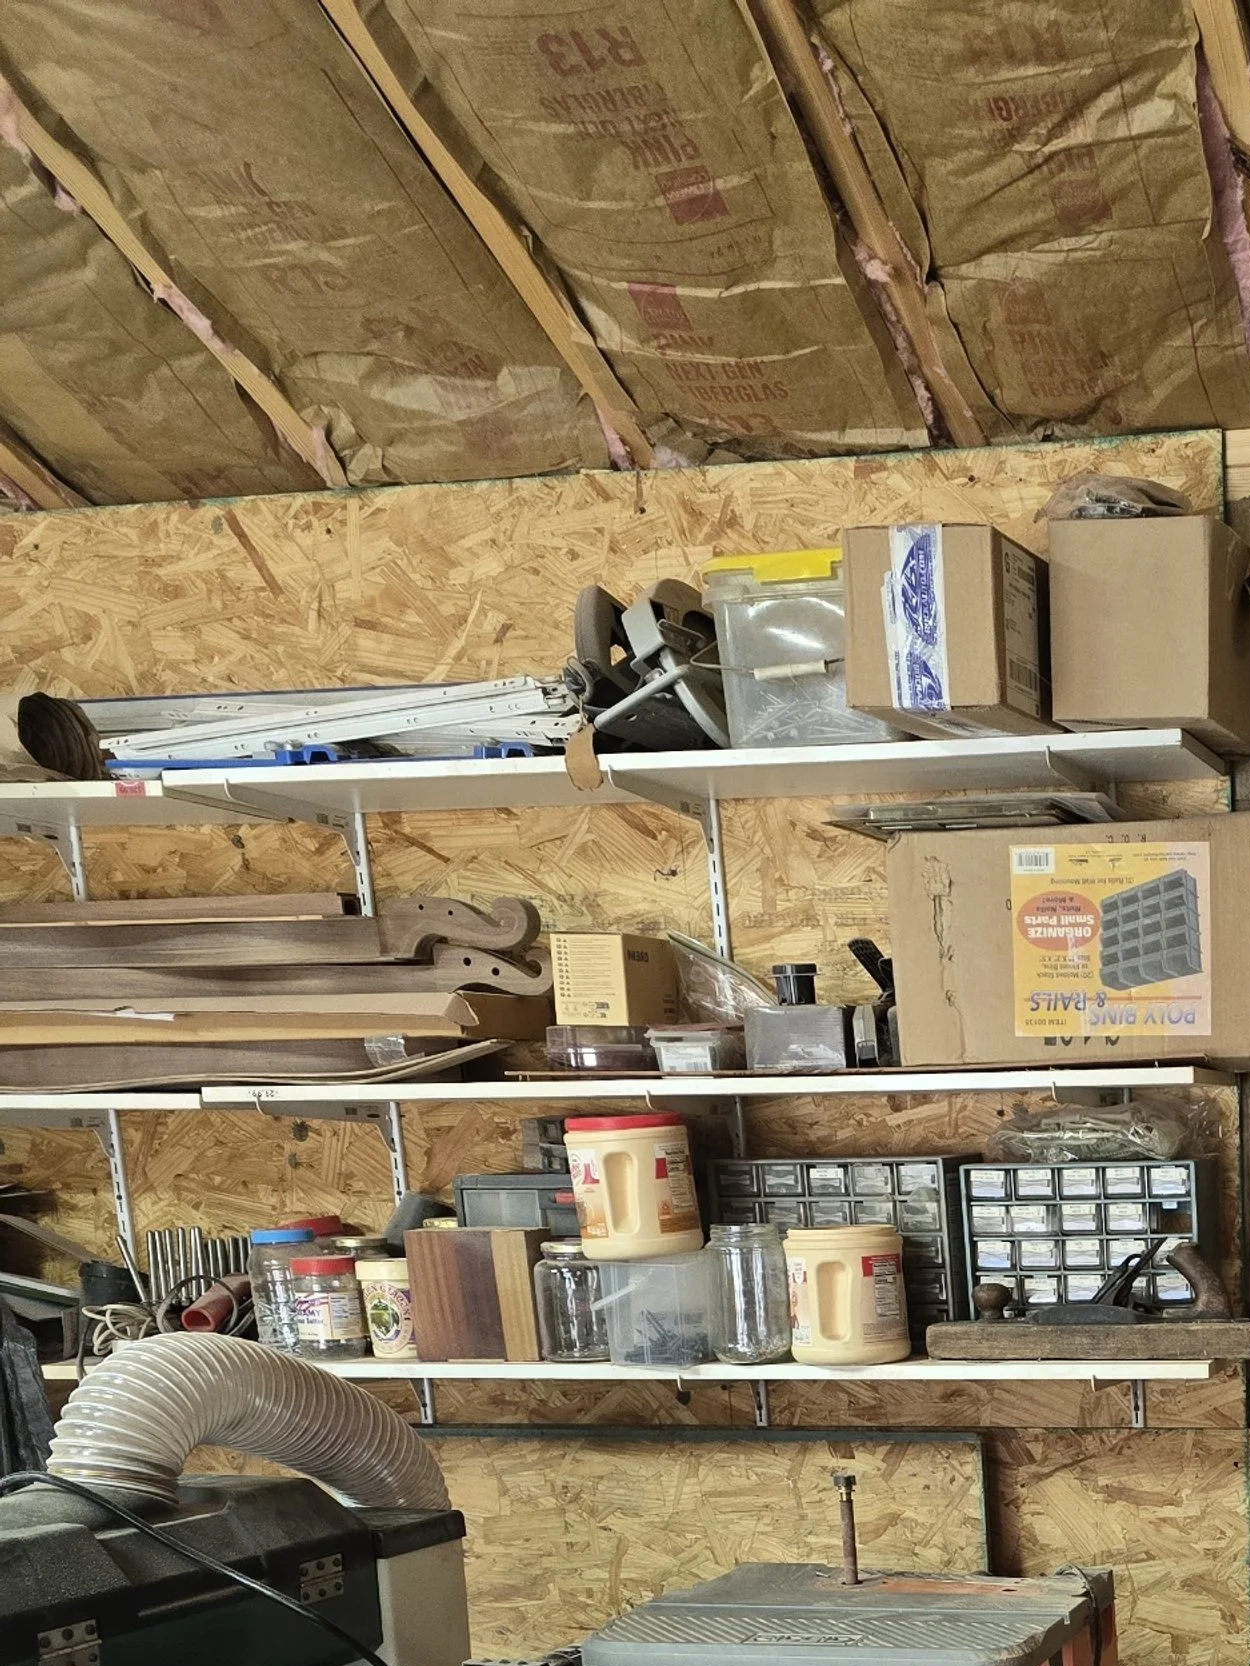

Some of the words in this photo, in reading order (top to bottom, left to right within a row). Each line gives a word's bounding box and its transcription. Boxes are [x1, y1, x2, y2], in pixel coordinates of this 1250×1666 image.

[537, 25, 648, 77] R13
[664, 361, 715, 381] NEXT
[1024, 914, 1058, 925] Parts
[1061, 914, 1095, 925] Small
[1028, 926, 1092, 938] ORGANIZE
[1030, 991, 1087, 1011] RAILS
[1097, 991, 1107, 1008] &
[1089, 1002, 1137, 1026] BINS
[1143, 1002, 1197, 1025] POLY
